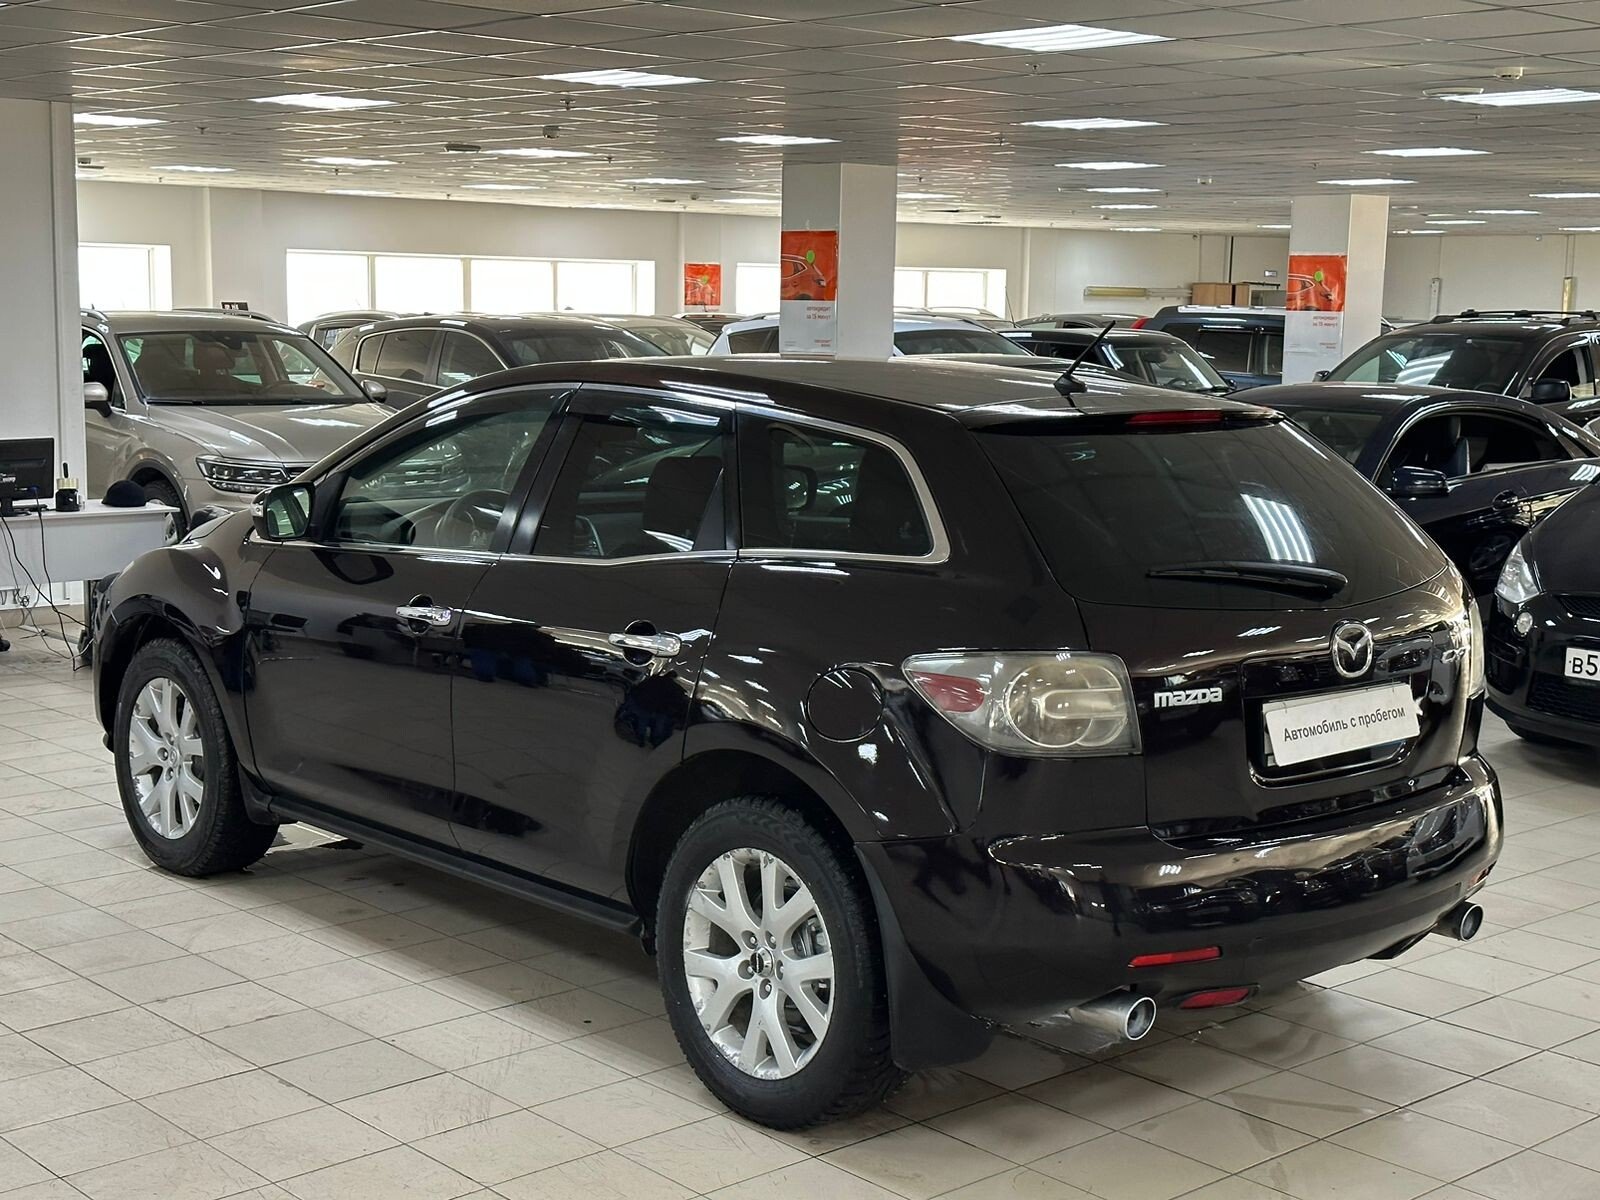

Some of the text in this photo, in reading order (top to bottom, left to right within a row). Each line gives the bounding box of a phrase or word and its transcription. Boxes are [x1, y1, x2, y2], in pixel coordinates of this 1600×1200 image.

[1284, 707, 1405, 741] Автомобиль с пробегом
